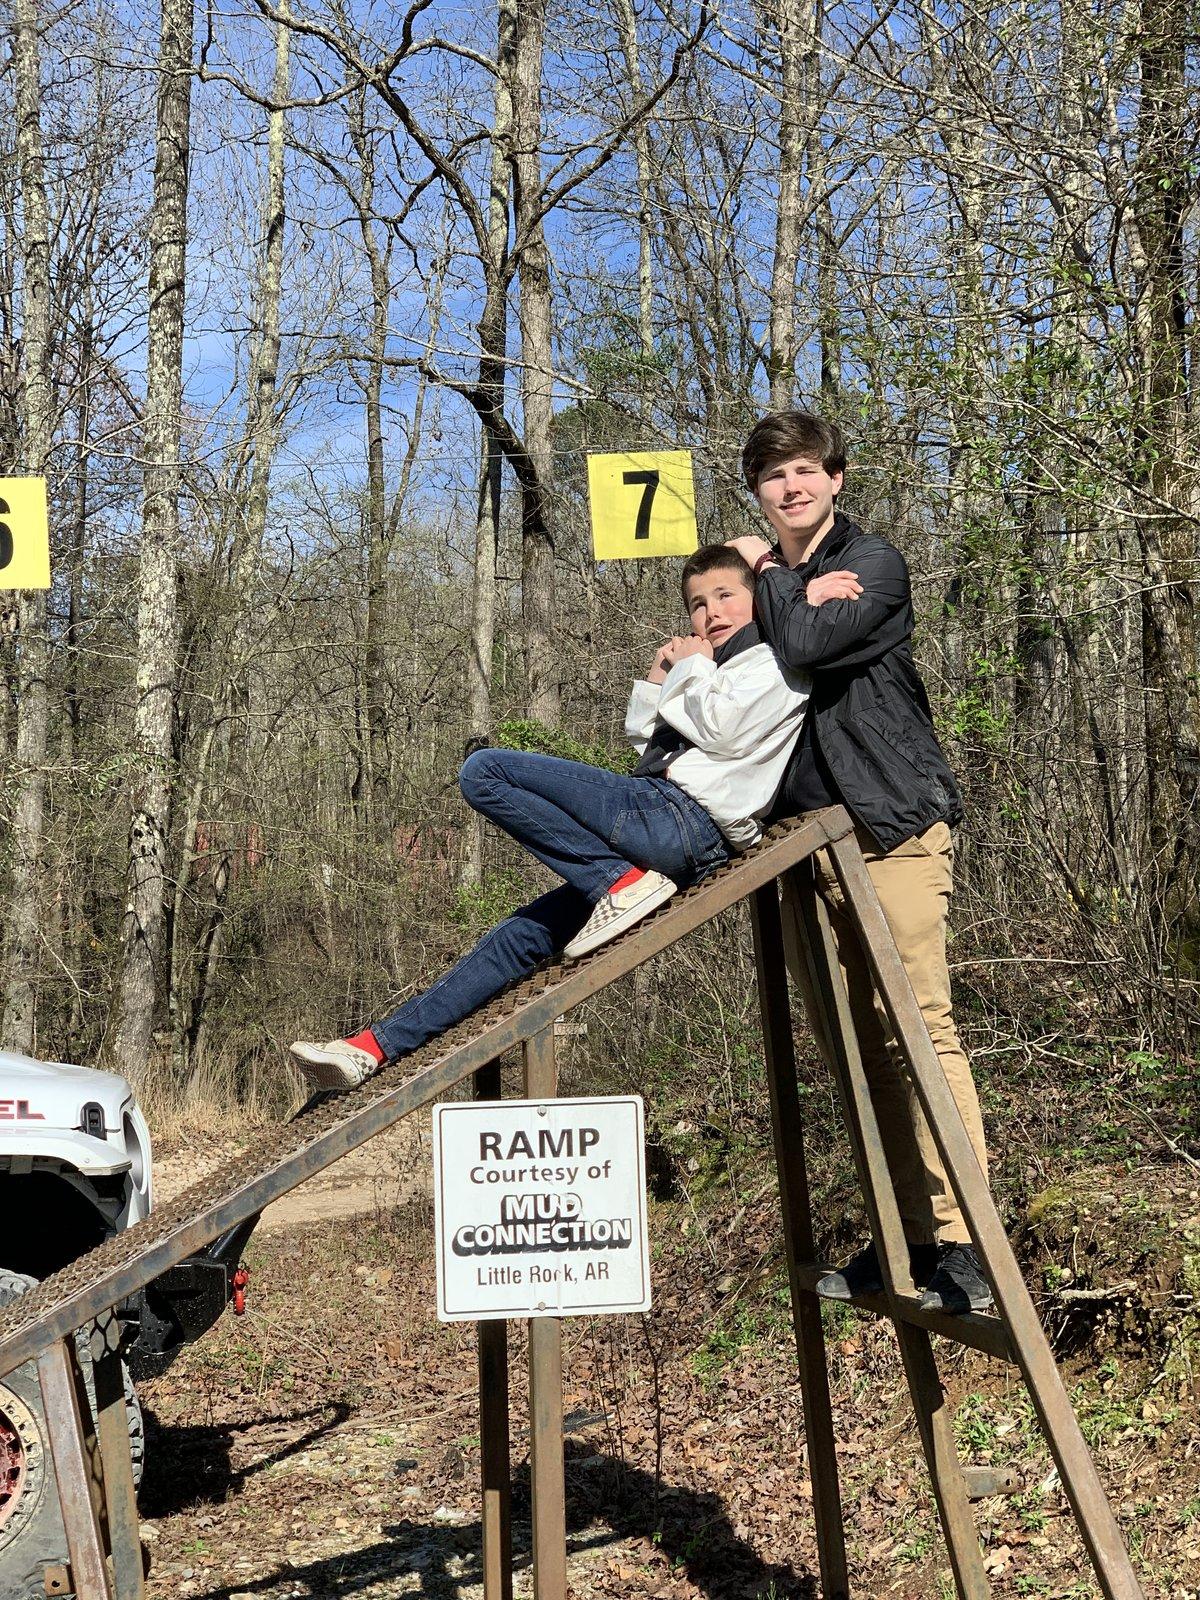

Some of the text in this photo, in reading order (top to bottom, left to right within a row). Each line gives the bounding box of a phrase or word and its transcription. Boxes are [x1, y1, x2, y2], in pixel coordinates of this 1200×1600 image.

[622, 469, 660, 540] 7
[479, 1127, 600, 1161] RAMP
[470, 1159, 612, 1185] Courtesy of
[501, 1192, 583, 1224] MUD
[452, 1218, 632, 1257] CONNECTION
[477, 1265, 522, 1286] Little
[585, 1262, 610, 1280] AR
